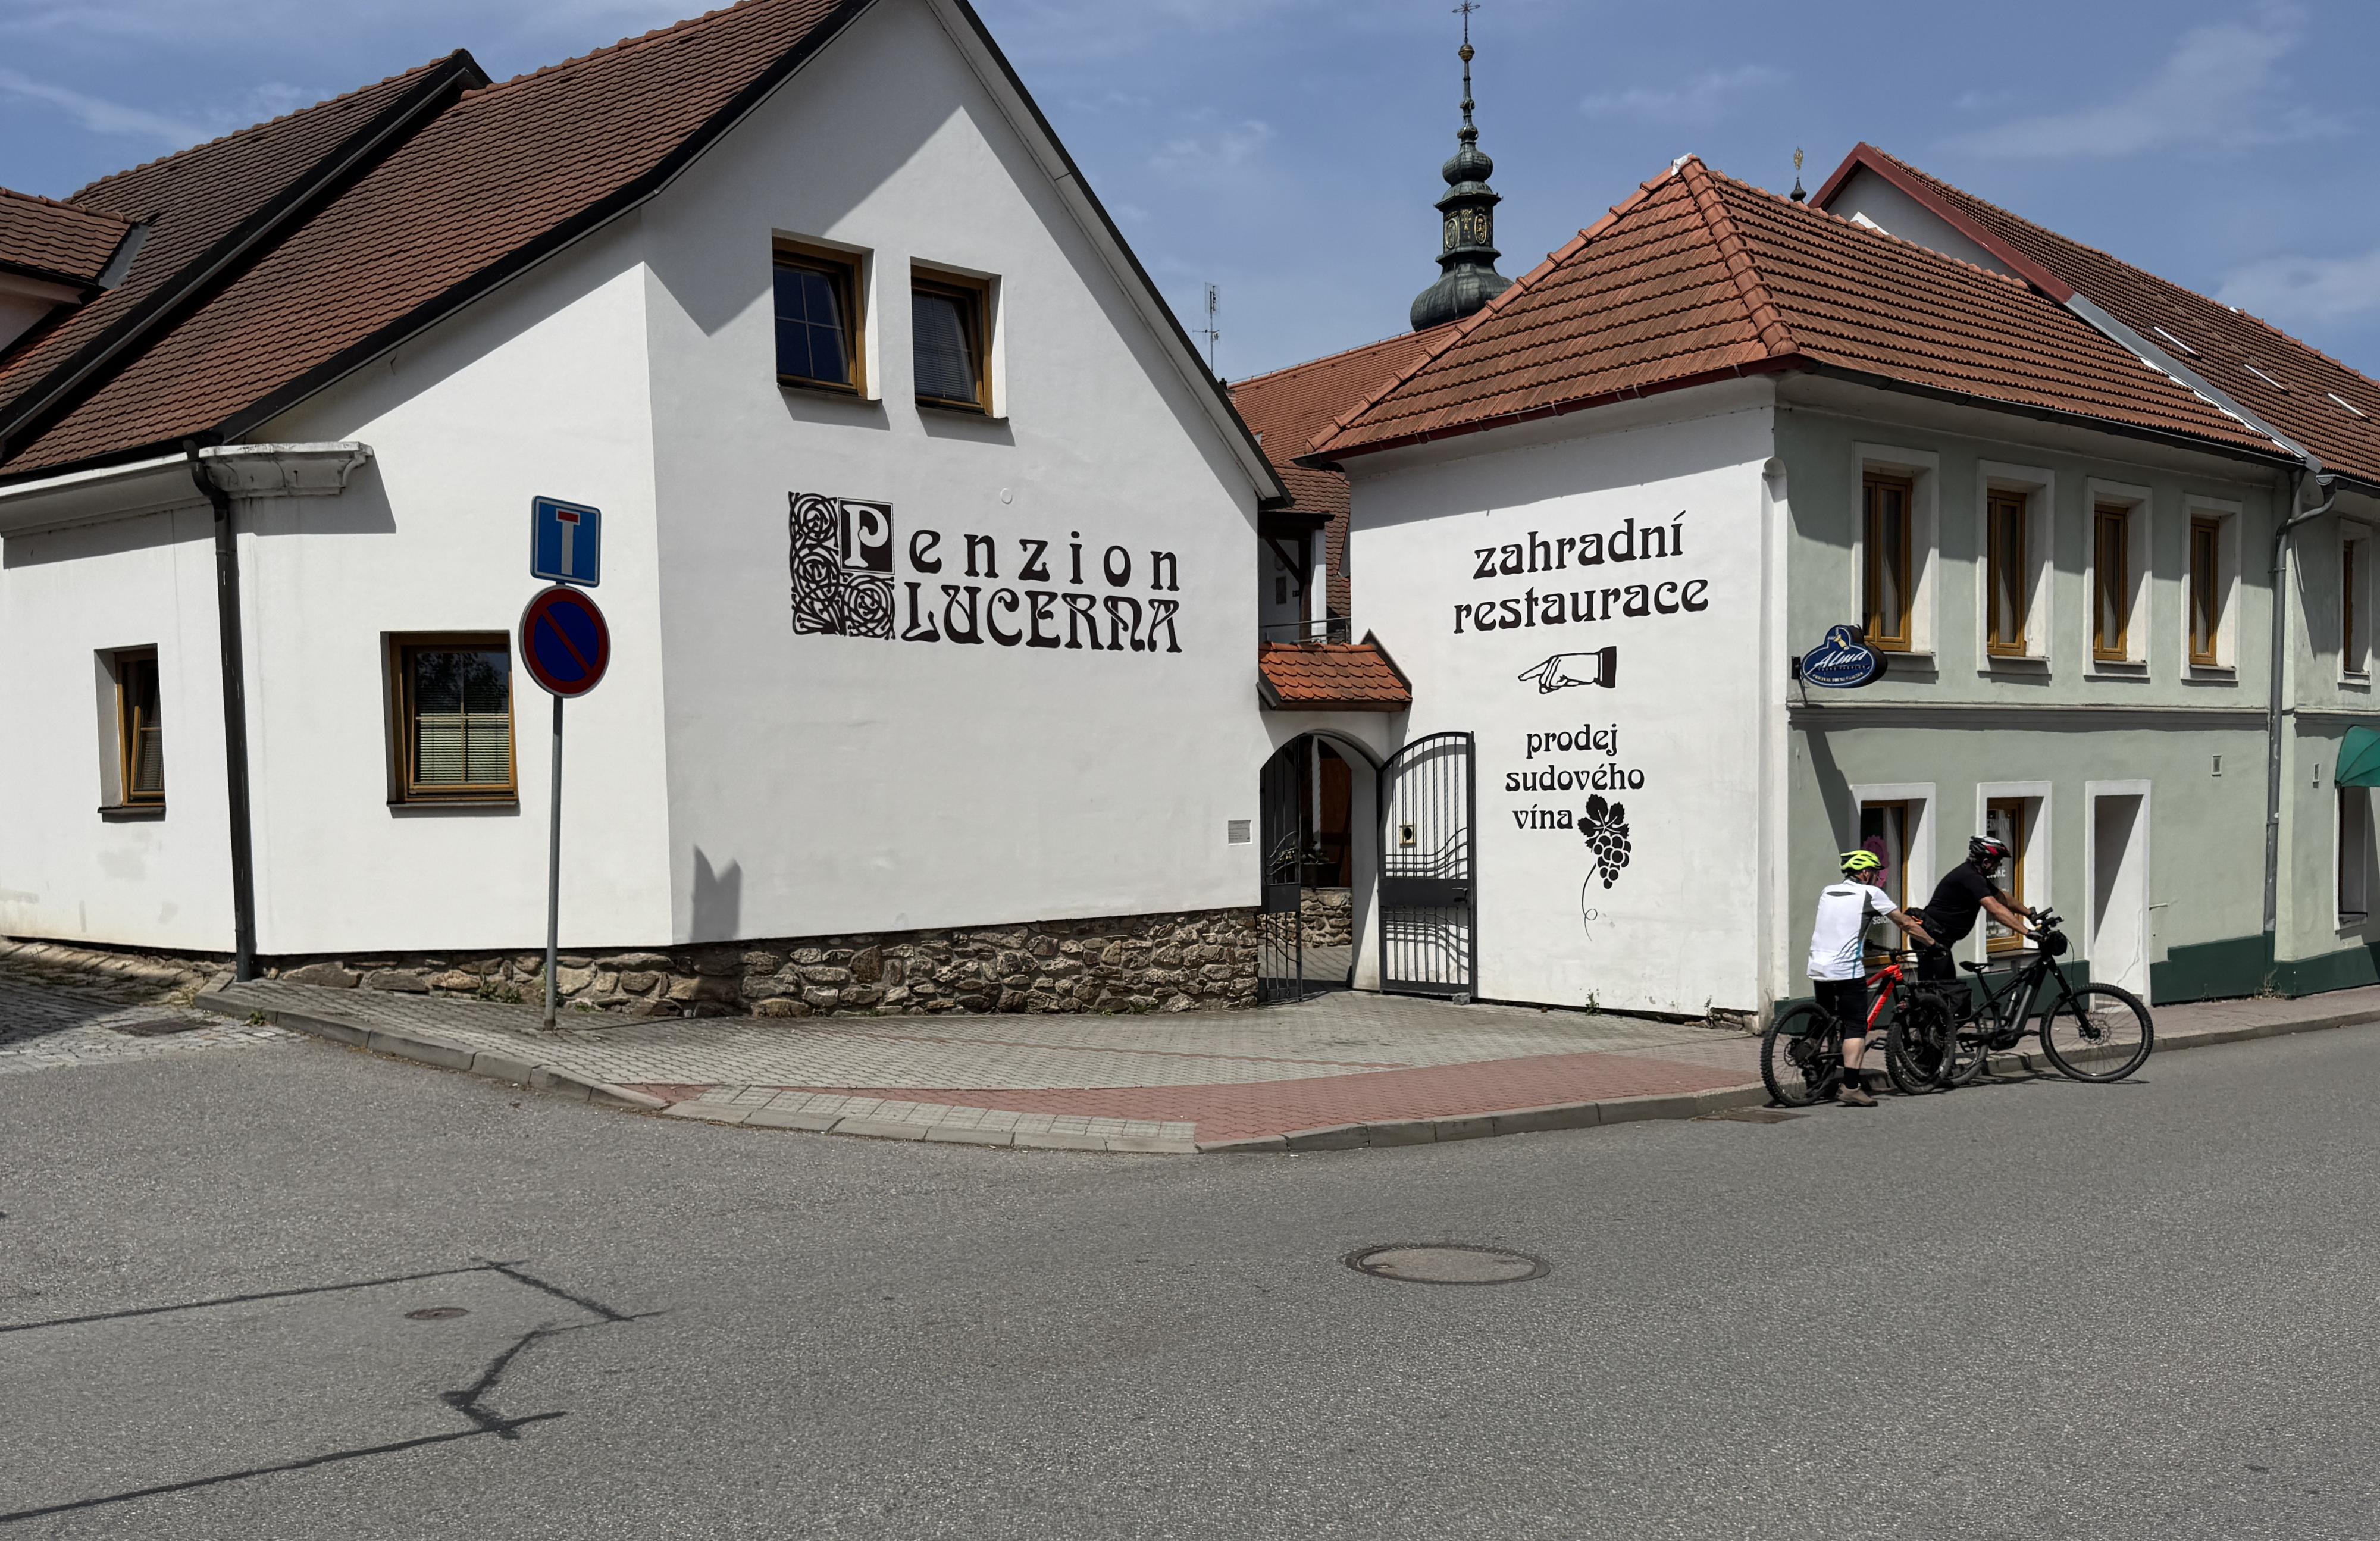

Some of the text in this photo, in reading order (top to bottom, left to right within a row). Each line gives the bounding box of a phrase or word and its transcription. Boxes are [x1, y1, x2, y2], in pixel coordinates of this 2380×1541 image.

[840, 503, 1181, 592] Penzion
[1473, 510, 1686, 580] zahradní
[901, 582, 1183, 653] LUCERNA
[1454, 578, 1709, 634] restaurace
[1526, 723, 1618, 759] prodej
[1505, 763, 1645, 792] sudového
[1512, 804, 1573, 829] vína
